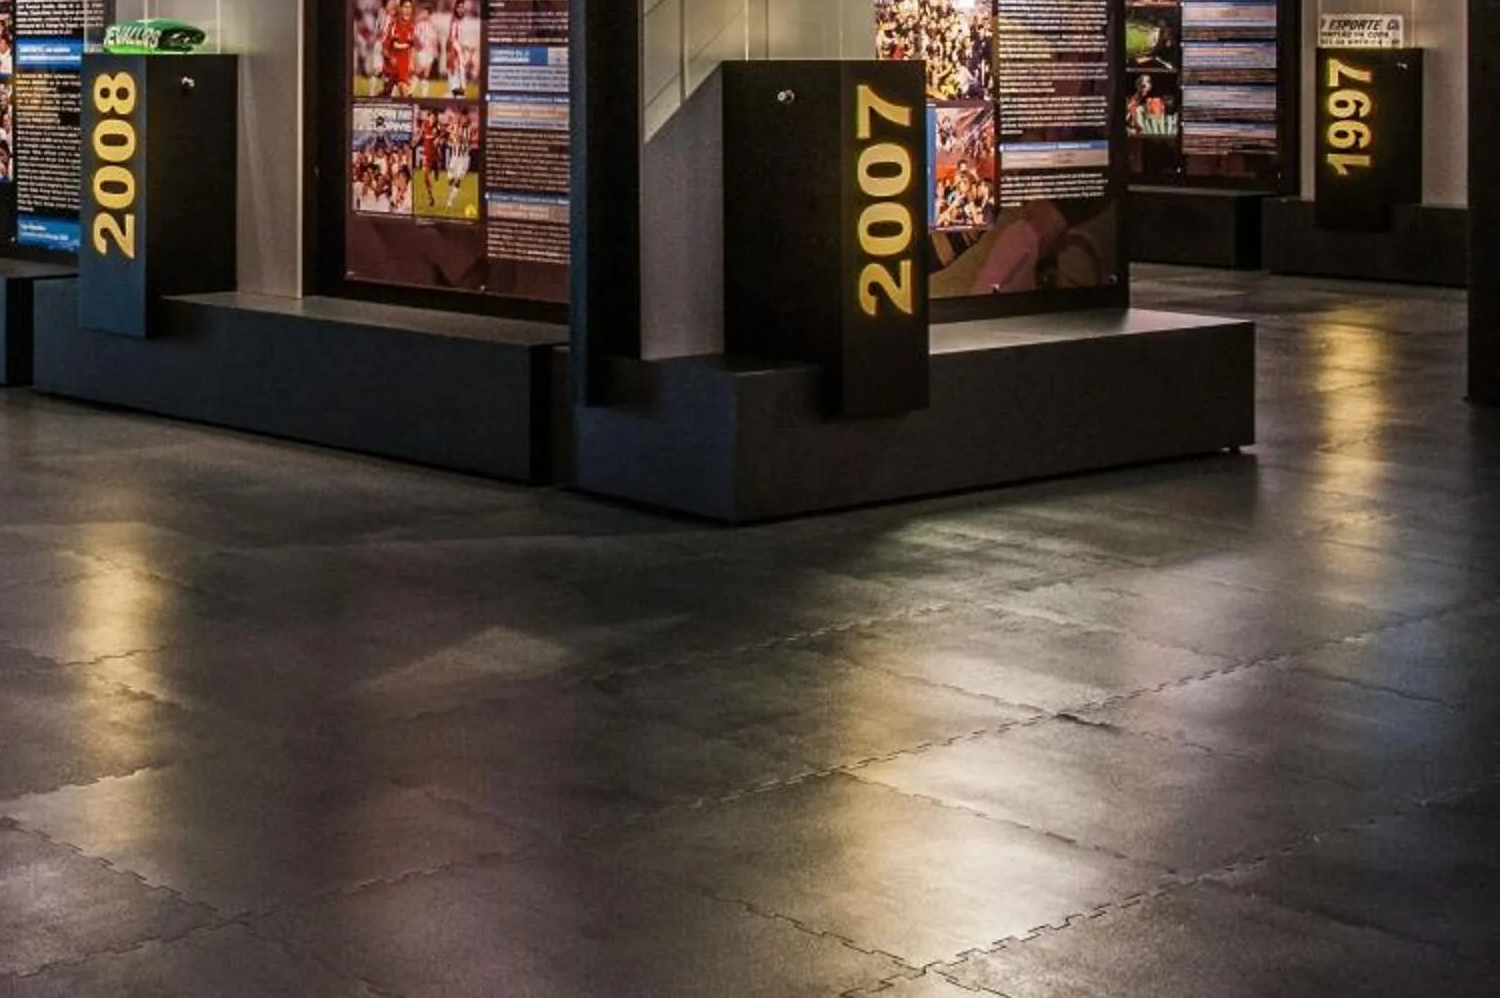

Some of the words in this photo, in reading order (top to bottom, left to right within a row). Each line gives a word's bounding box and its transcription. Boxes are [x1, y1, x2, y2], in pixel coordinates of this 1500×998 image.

[92, 70, 137, 260] 2008
[856, 83, 914, 318] 2007
[1327, 58, 1376, 175] 1997
